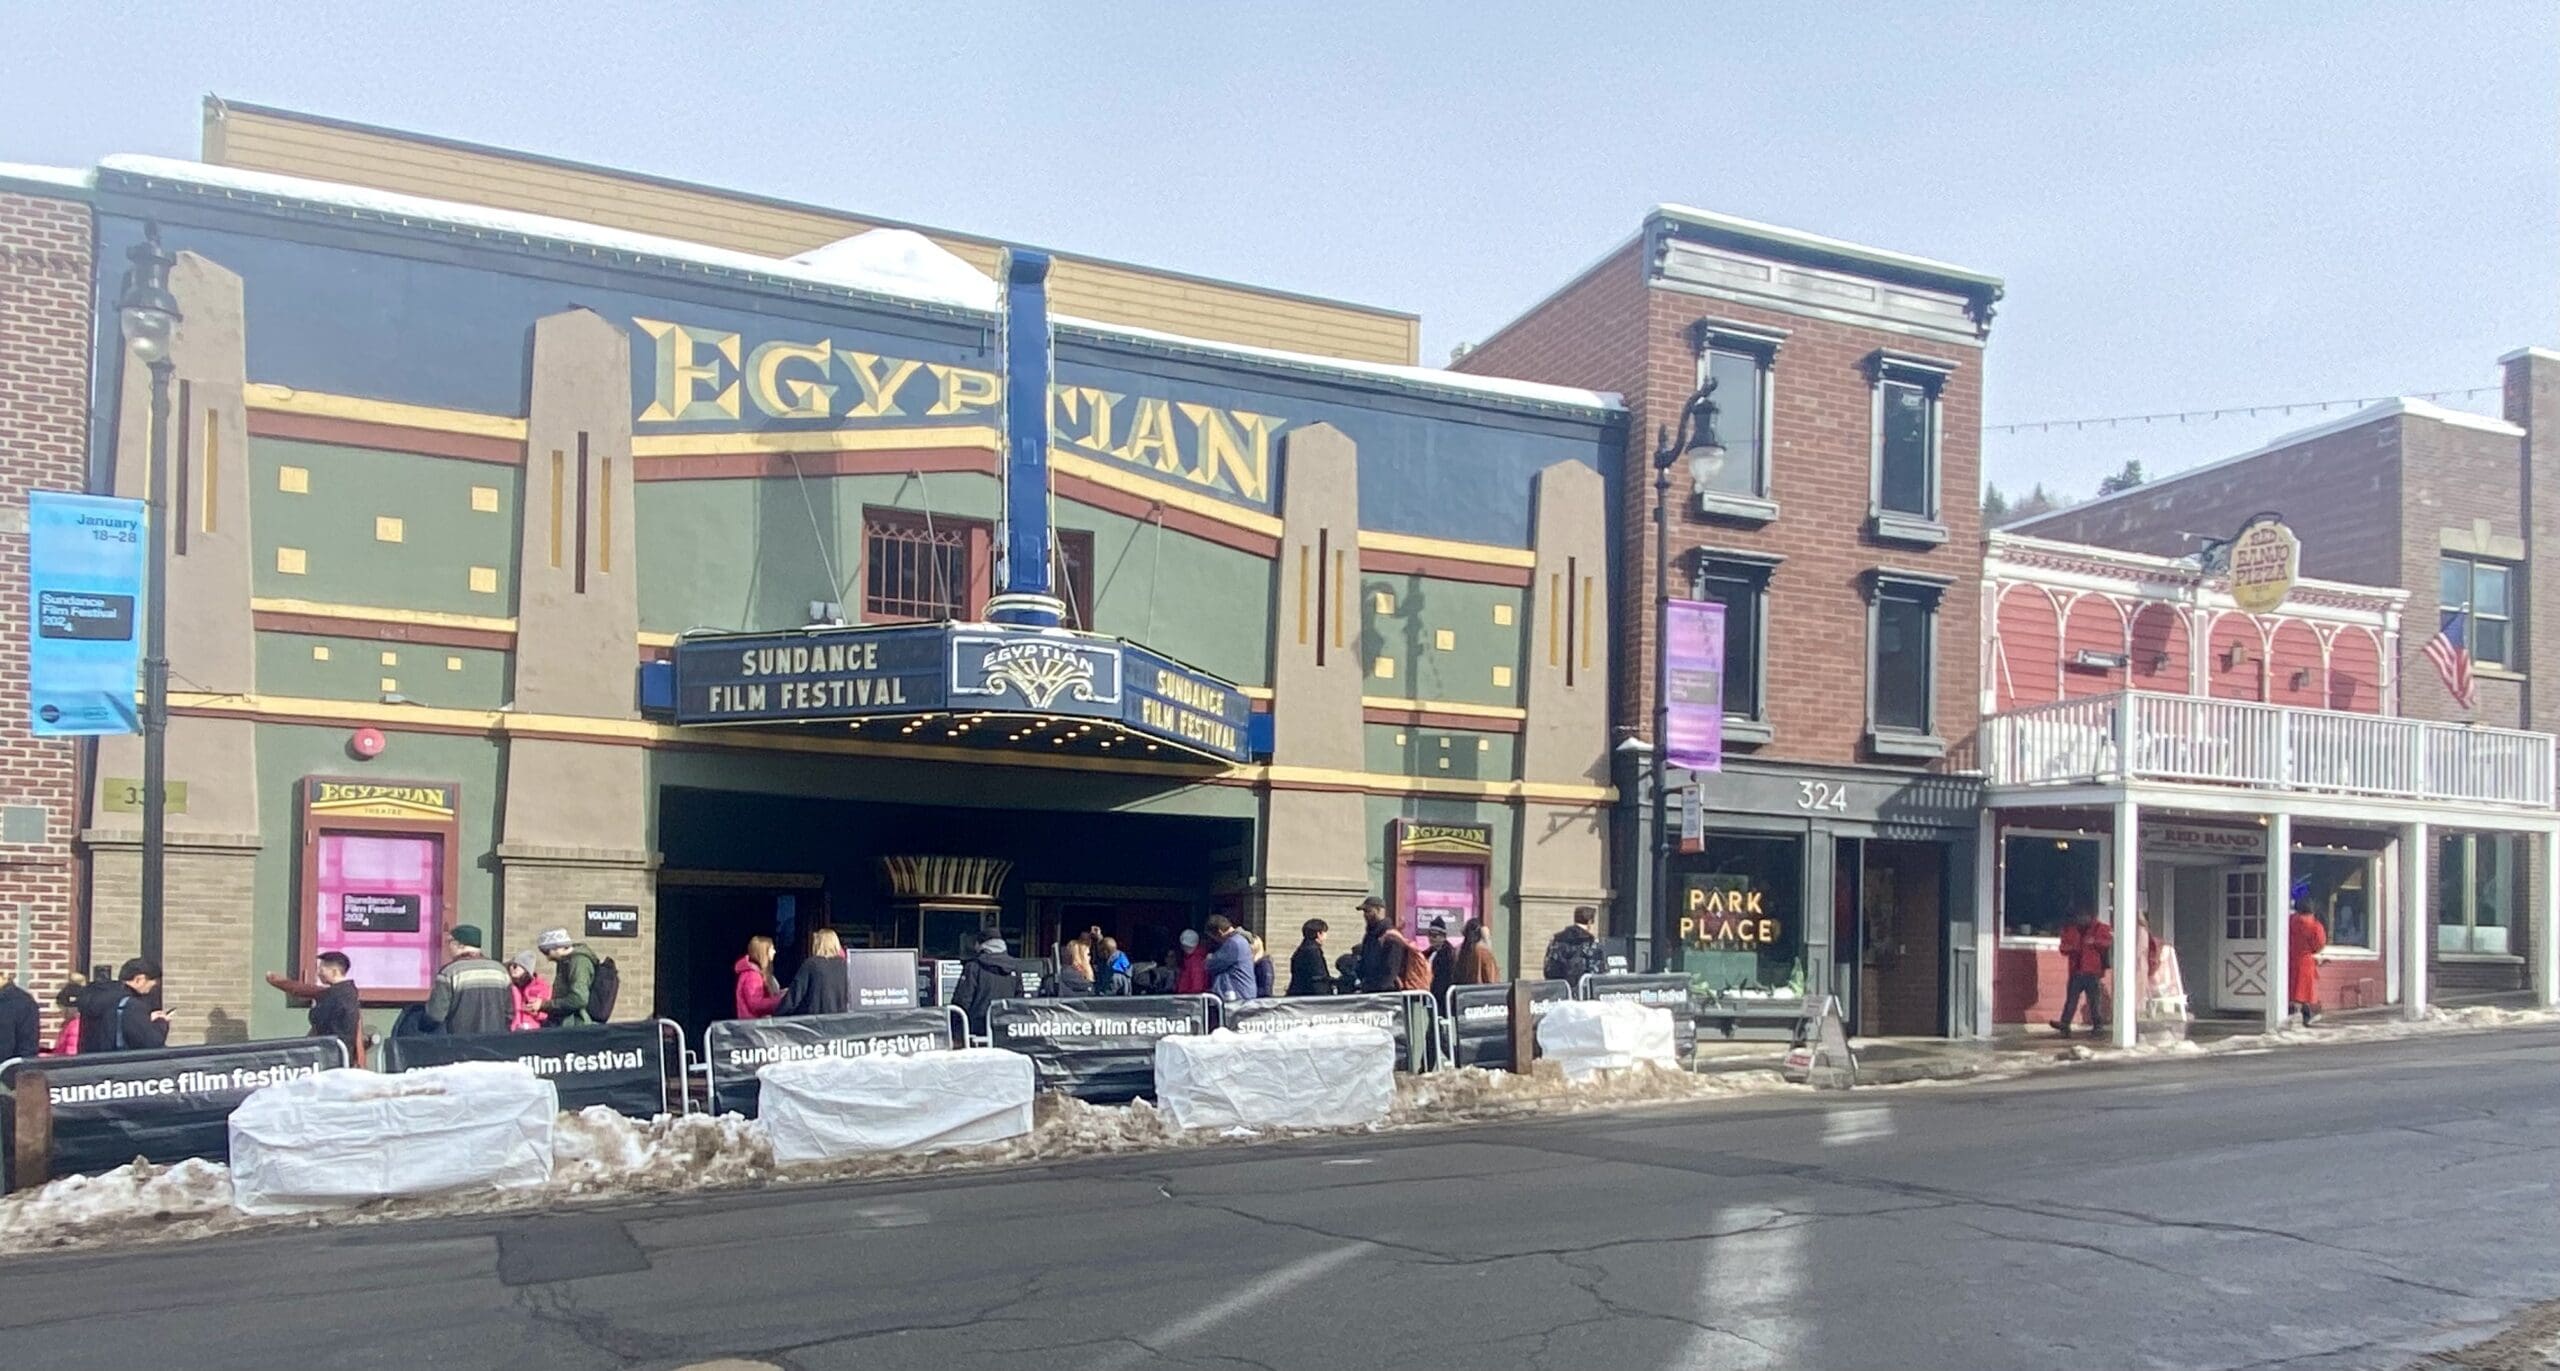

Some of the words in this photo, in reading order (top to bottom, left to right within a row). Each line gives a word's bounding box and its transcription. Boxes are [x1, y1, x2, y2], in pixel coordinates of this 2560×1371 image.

[632, 316, 1287, 503] EGYPIAN
[77, 513, 138, 531] January
[2249, 528, 2277, 546] RED
[2237, 545, 2289, 568] BANJO
[2235, 564, 2288, 587] PIZZA
[42, 594, 105, 608] Sundance
[42, 606, 69, 617] Film
[71, 607, 117, 619] Festival
[42, 616, 73, 632] 2024
[742, 642, 878, 676] SUNDANCE
[983, 645, 1094, 676] EGYPTIAN
[709, 685, 766, 713] FILM
[781, 677, 906, 710] FESTIVAL
[1157, 669, 1225, 717] SUNDANCE
[1142, 697, 1175, 732] FILM
[1179, 707, 1237, 752] FESTIVAL
[319, 783, 446, 808] EGYPTIAN
[1797, 781, 1847, 812] 324
[1407, 825, 1485, 842] EGYPTIAN
[2164, 829, 2199, 843] RED
[2204, 832, 2260, 847] BANJO
[344, 904, 366, 914] Film
[1690, 889, 1763, 914] PARK
[587, 911, 637, 920] VOLUNTEER
[602, 921, 622, 930] LINE
[1680, 917, 1772, 941] PLACE
[860, 988, 873, 997] Do
[873, 989, 887, 997] not
[1007, 1019, 1091, 1037] sundance
[1094, 1018, 1128, 1035] film
[1130, 1016, 1191, 1035] festival
[564, 1048, 644, 1073] festival
[730, 1041, 825, 1065] sundance
[827, 1038, 866, 1058] film
[868, 1033, 936, 1054] festival
[49, 1076, 177, 1104] sundance
[177, 1070, 229, 1094] film
[232, 1062, 321, 1089] festival
